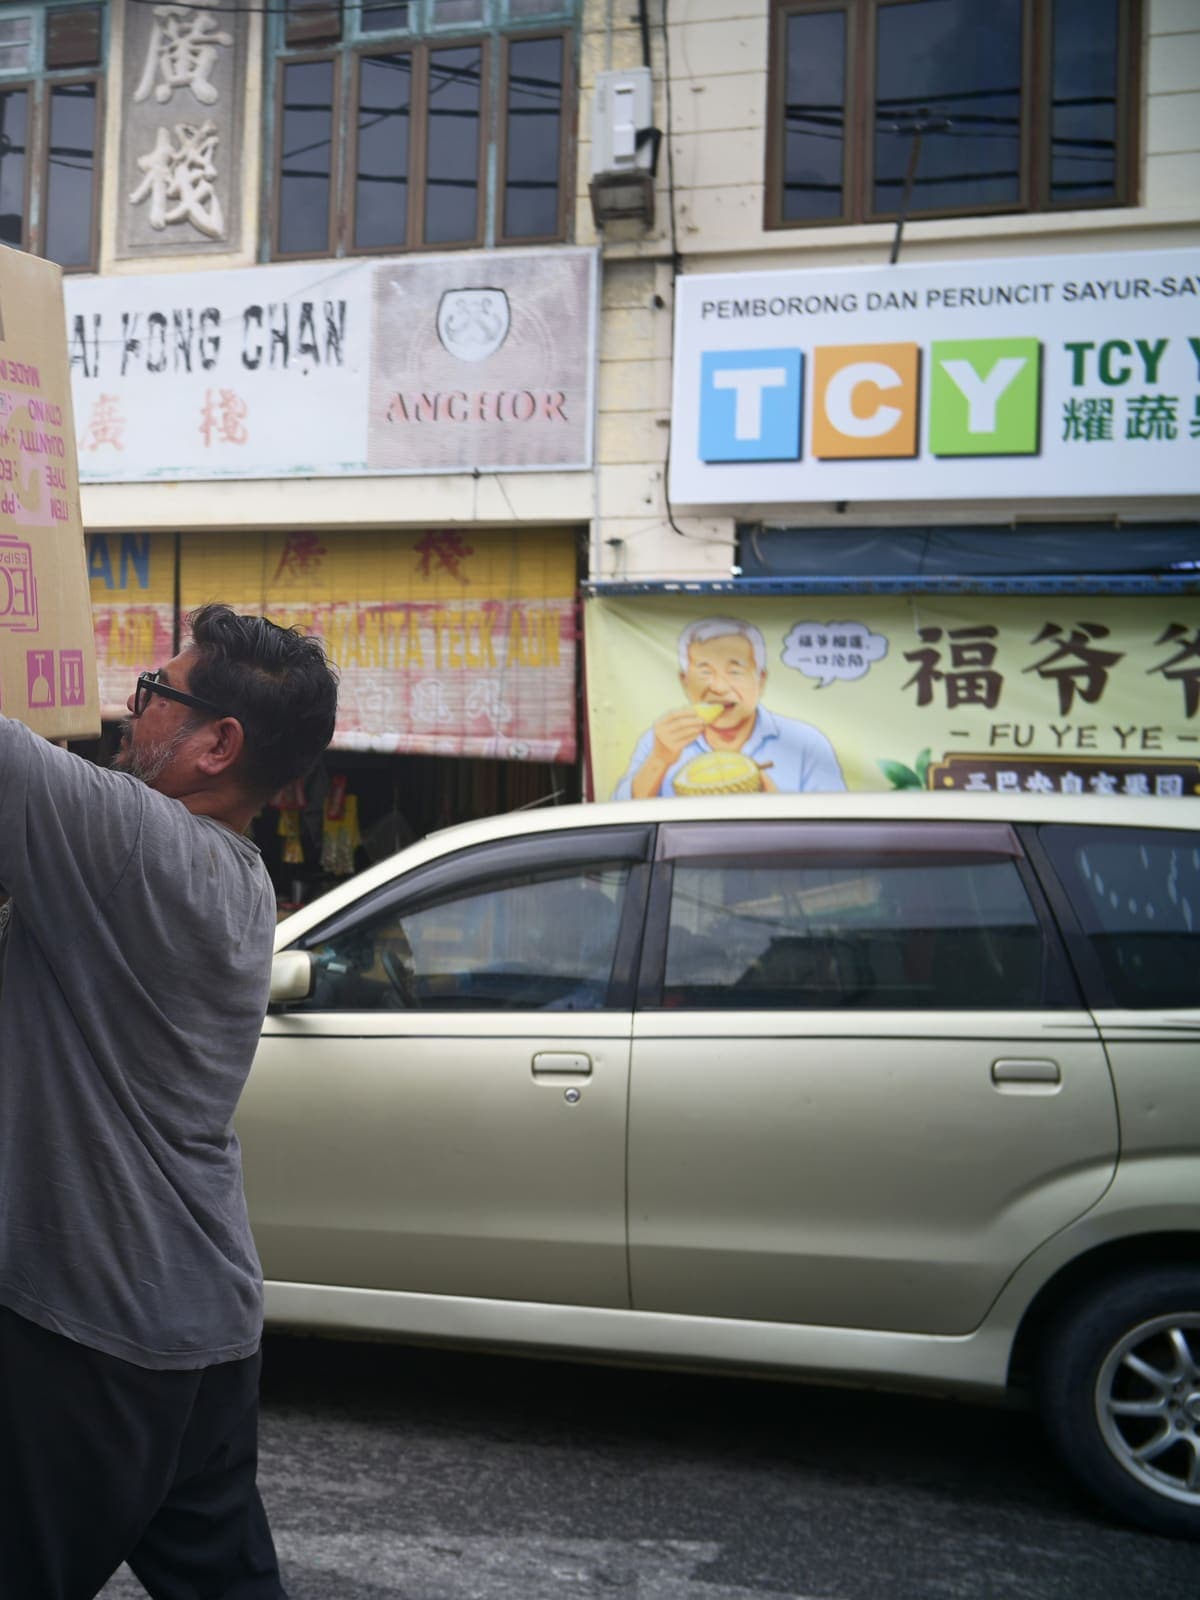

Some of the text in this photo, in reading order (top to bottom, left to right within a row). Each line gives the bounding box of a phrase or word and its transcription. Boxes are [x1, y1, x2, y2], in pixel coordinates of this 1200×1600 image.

[701, 276, 1200, 320] PEMBORONG DAN PERUNCIT SAYUR-SA
[240, 300, 348, 375] CHAN
[8, 360, 41, 388] MADE
[1064, 337, 1170, 387] TCY
[385, 389, 569, 424] ANCHOR
[713, 357, 1028, 441] TCY
[1062, 394, 1200, 442] 耀蔬
[19, 430, 65, 458] QUANTITY
[46, 465, 67, 490] TYPE
[1, 492, 16, 514] PP
[50, 497, 69, 521] ITEM
[988, 723, 1035, 748] FU
[1050, 723, 1099, 749] YE
[1115, 724, 1164, 750] YE
